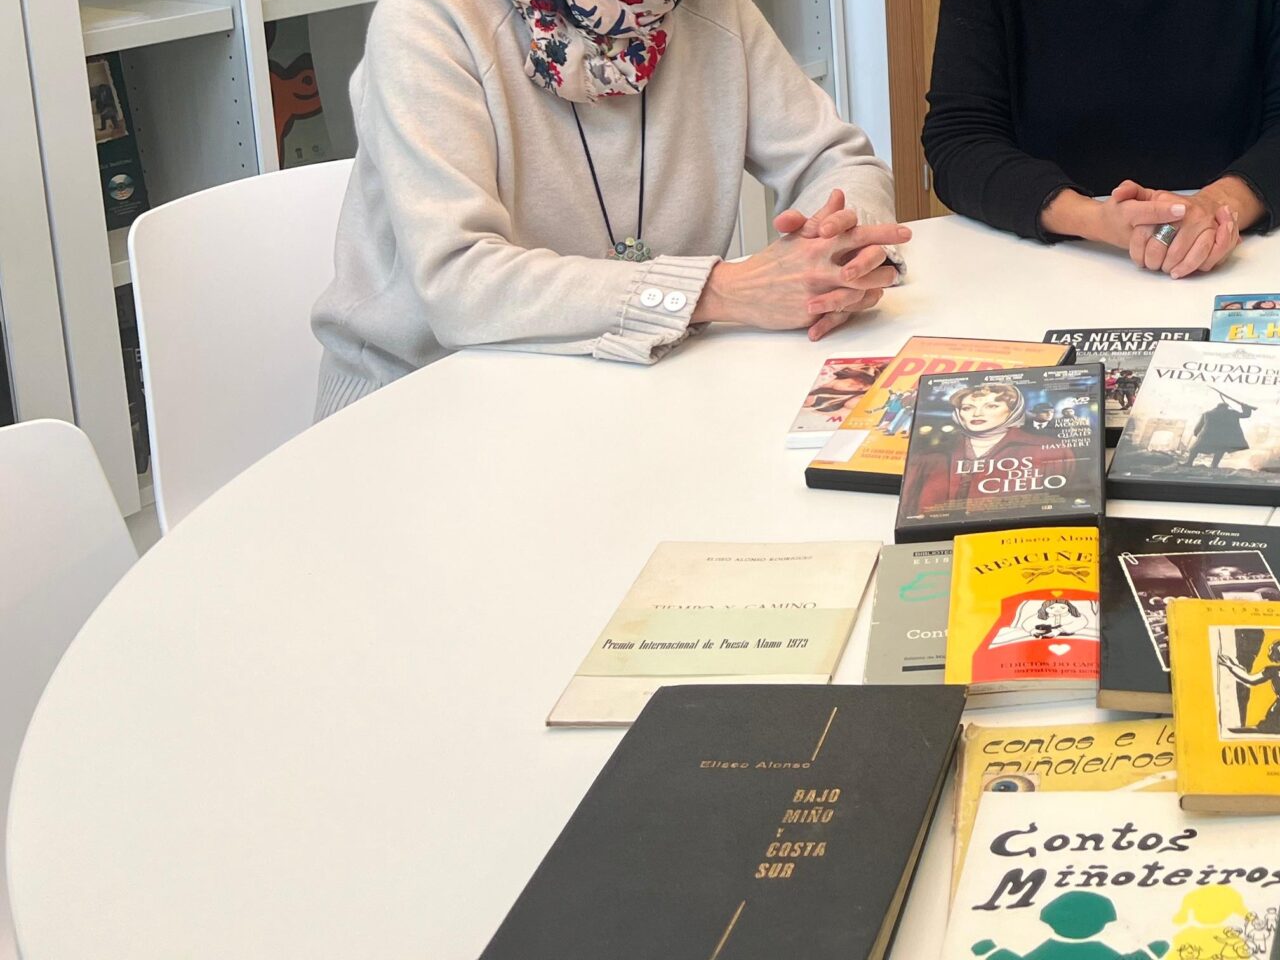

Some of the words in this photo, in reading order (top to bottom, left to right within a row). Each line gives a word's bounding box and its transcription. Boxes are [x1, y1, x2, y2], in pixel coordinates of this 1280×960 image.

[1050, 331, 1091, 343] LAS
[1092, 331, 1157, 343] NIEVES
[1162, 331, 1193, 342] DEL
[1228, 323, 1260, 341] EL
[1156, 368, 1207, 383] VIDA
[1183, 361, 1261, 376] CIUDAD
[1041, 442, 1089, 450] HAYSBERT
[956, 456, 1033, 475] LEJOS
[1008, 468, 1043, 480] DEL
[978, 475, 1067, 494] CIELO
[1001, 536, 1050, 545] Eliseo
[1176, 537, 1202, 545] rua
[1209, 536, 1227, 546] do
[1232, 540, 1268, 549] noxo
[913, 557, 950, 566] ELIS
[973, 550, 1099, 575] REICIÑE
[906, 629, 949, 641] Cont
[602, 638, 635, 650] Premio
[638, 639, 701, 650] Internacional
[702, 638, 715, 650] de
[786, 638, 809, 648] 1973
[982, 732, 1094, 754] contos
[1114, 732, 1136, 747] e
[1157, 725, 1175, 746] le
[700, 760, 749, 769] Eliseo
[755, 760, 812, 769] Alonso
[983, 750, 1175, 776] miñoteiros
[793, 788, 841, 803] BAJO
[782, 806, 834, 823] MIÑO
[989, 822, 1198, 858] Contos
[766, 842, 827, 858] COSTA
[755, 862, 796, 879] SUR
